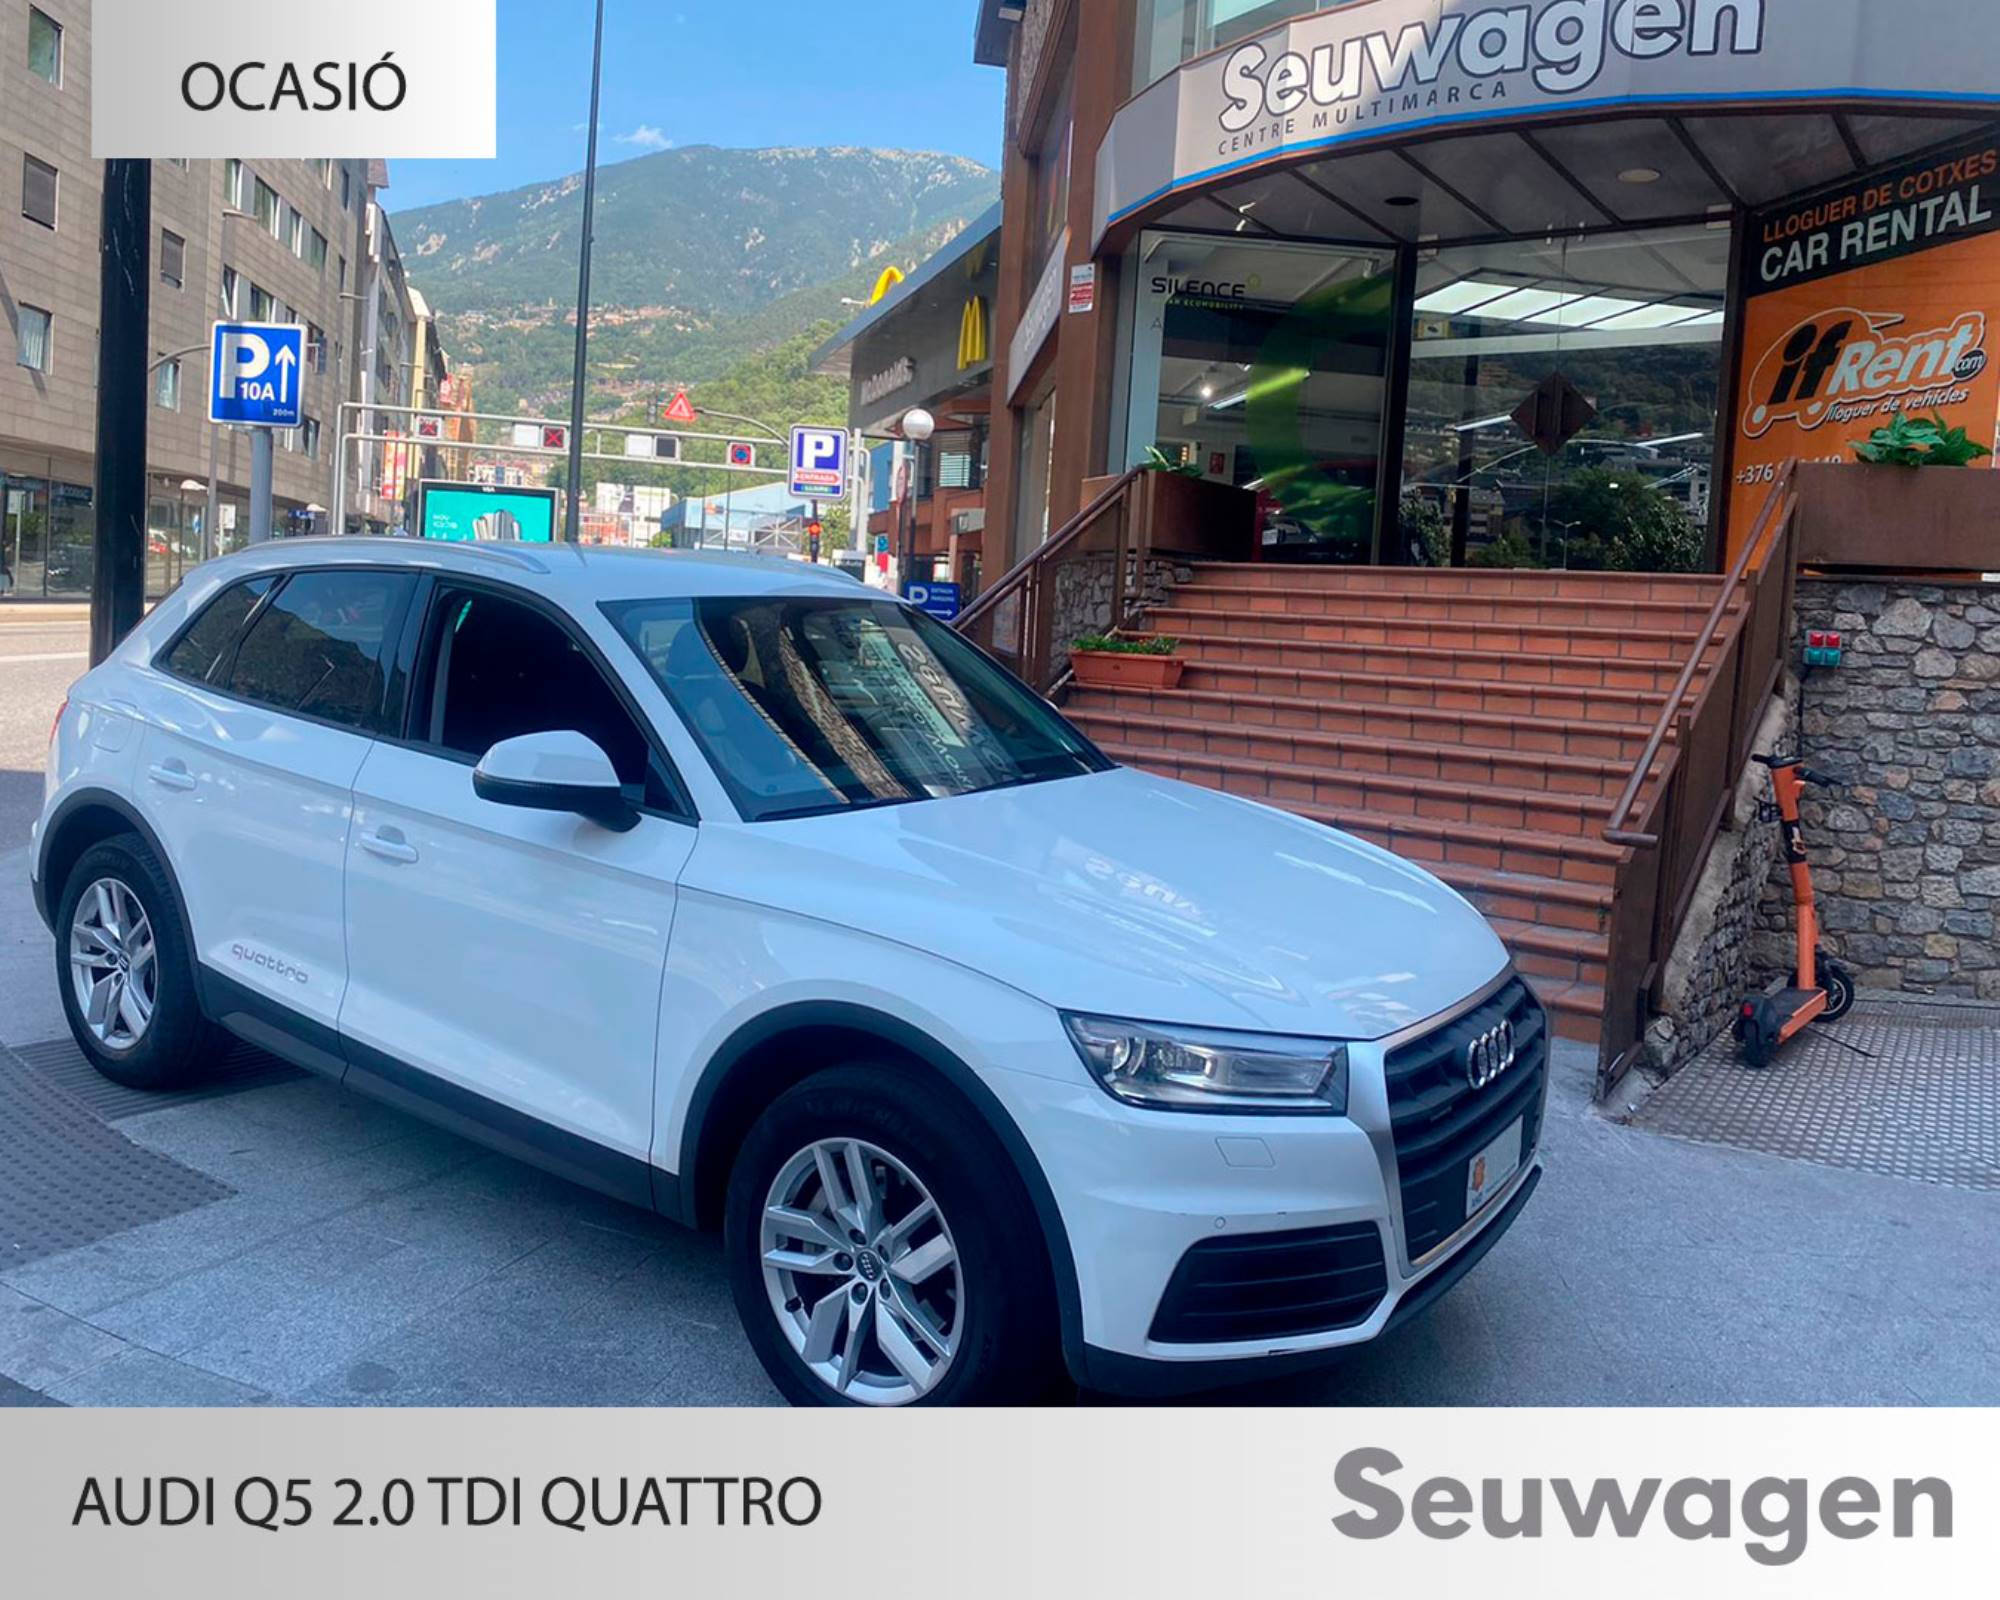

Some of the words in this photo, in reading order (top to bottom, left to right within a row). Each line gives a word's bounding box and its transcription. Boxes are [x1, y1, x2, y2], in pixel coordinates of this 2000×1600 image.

[1218, 0, 1765, 133] Seuwagen
[1218, 118, 1295, 156] CENTRE
[1312, 80, 1506, 130] MULTIMARCA
[1763, 195, 1857, 242] LLOGUER
[1863, 182, 1893, 211] DE
[1900, 149, 1997, 199] COTXES
[1760, 231, 1830, 282] CAR
[1839, 184, 1993, 260] RENTAL
[1151, 276, 1246, 300] SILENCE
[219, 332, 271, 399] P
[240, 381, 275, 400] 10A
[1825, 402, 1879, 421] lloguer
[1881, 396, 1901, 413] de
[802, 433, 836, 470] P
[1735, 462, 1775, 484] +376
[231, 943, 309, 984] quattro
